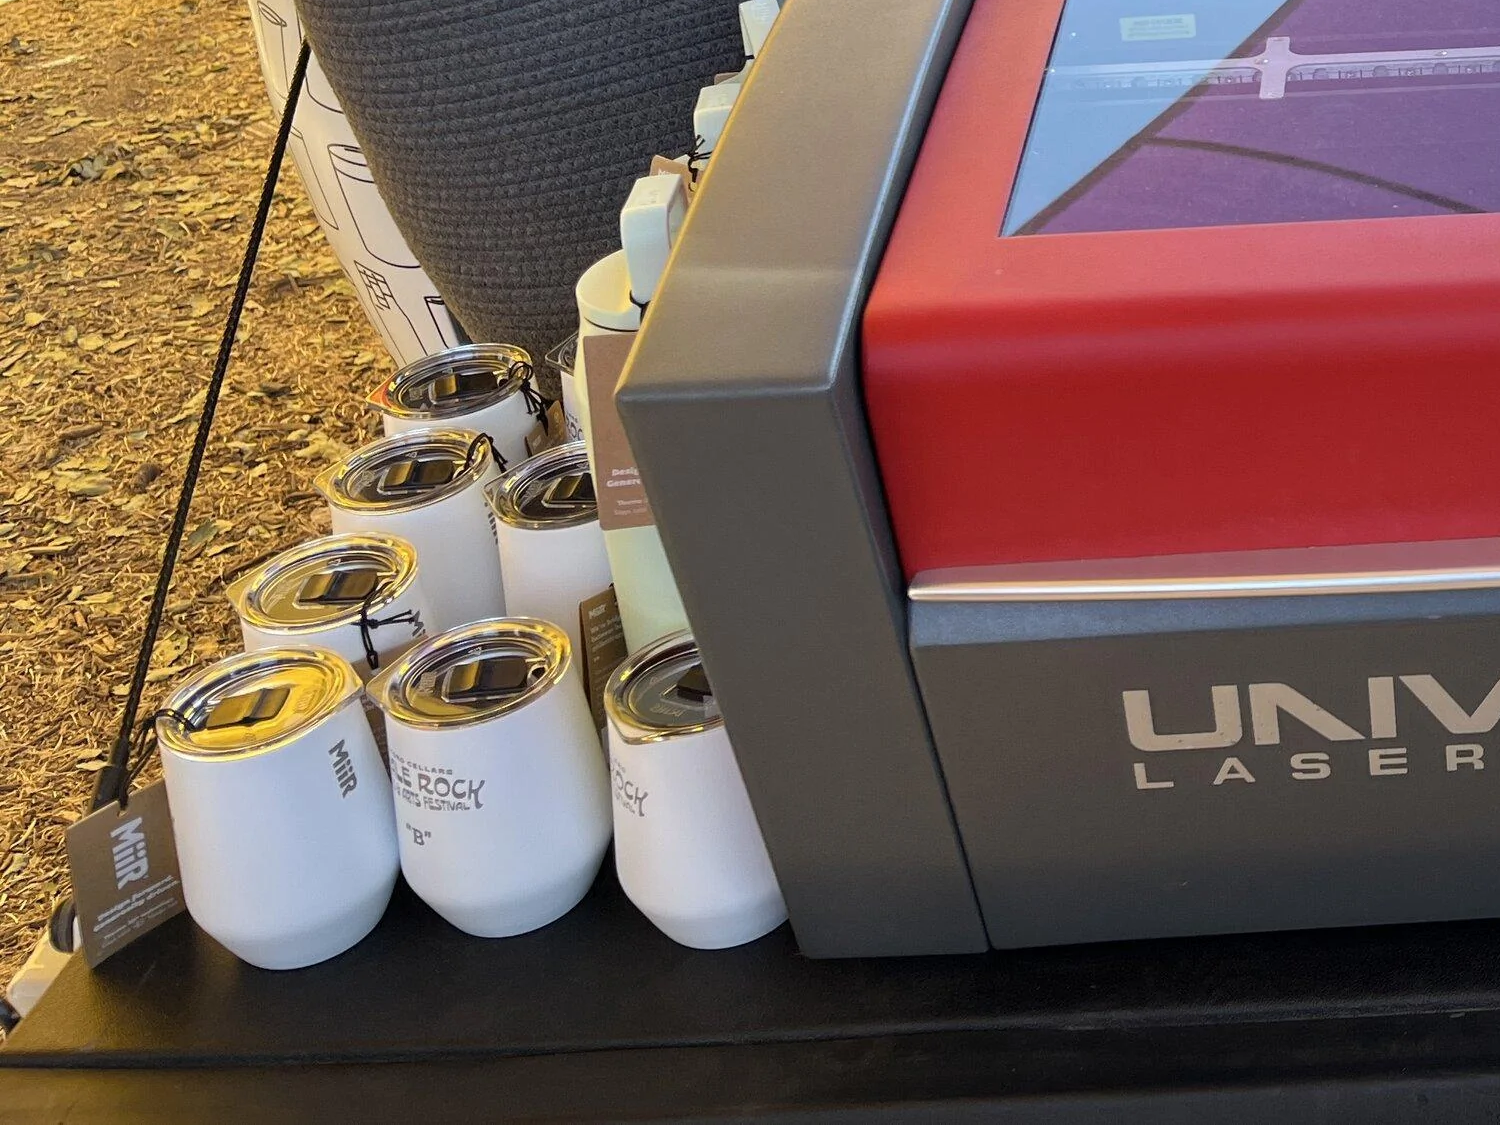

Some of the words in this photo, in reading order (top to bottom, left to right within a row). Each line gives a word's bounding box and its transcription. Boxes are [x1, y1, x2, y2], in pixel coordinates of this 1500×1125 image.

[327, 739, 358, 799] MiiR
[407, 761, 453, 775] CELLARS
[1133, 742, 1486, 791] LASER
[417, 773, 485, 809] ROCK
[423, 796, 470, 811] FESTIVAL
[110, 817, 149, 890] MiiR
